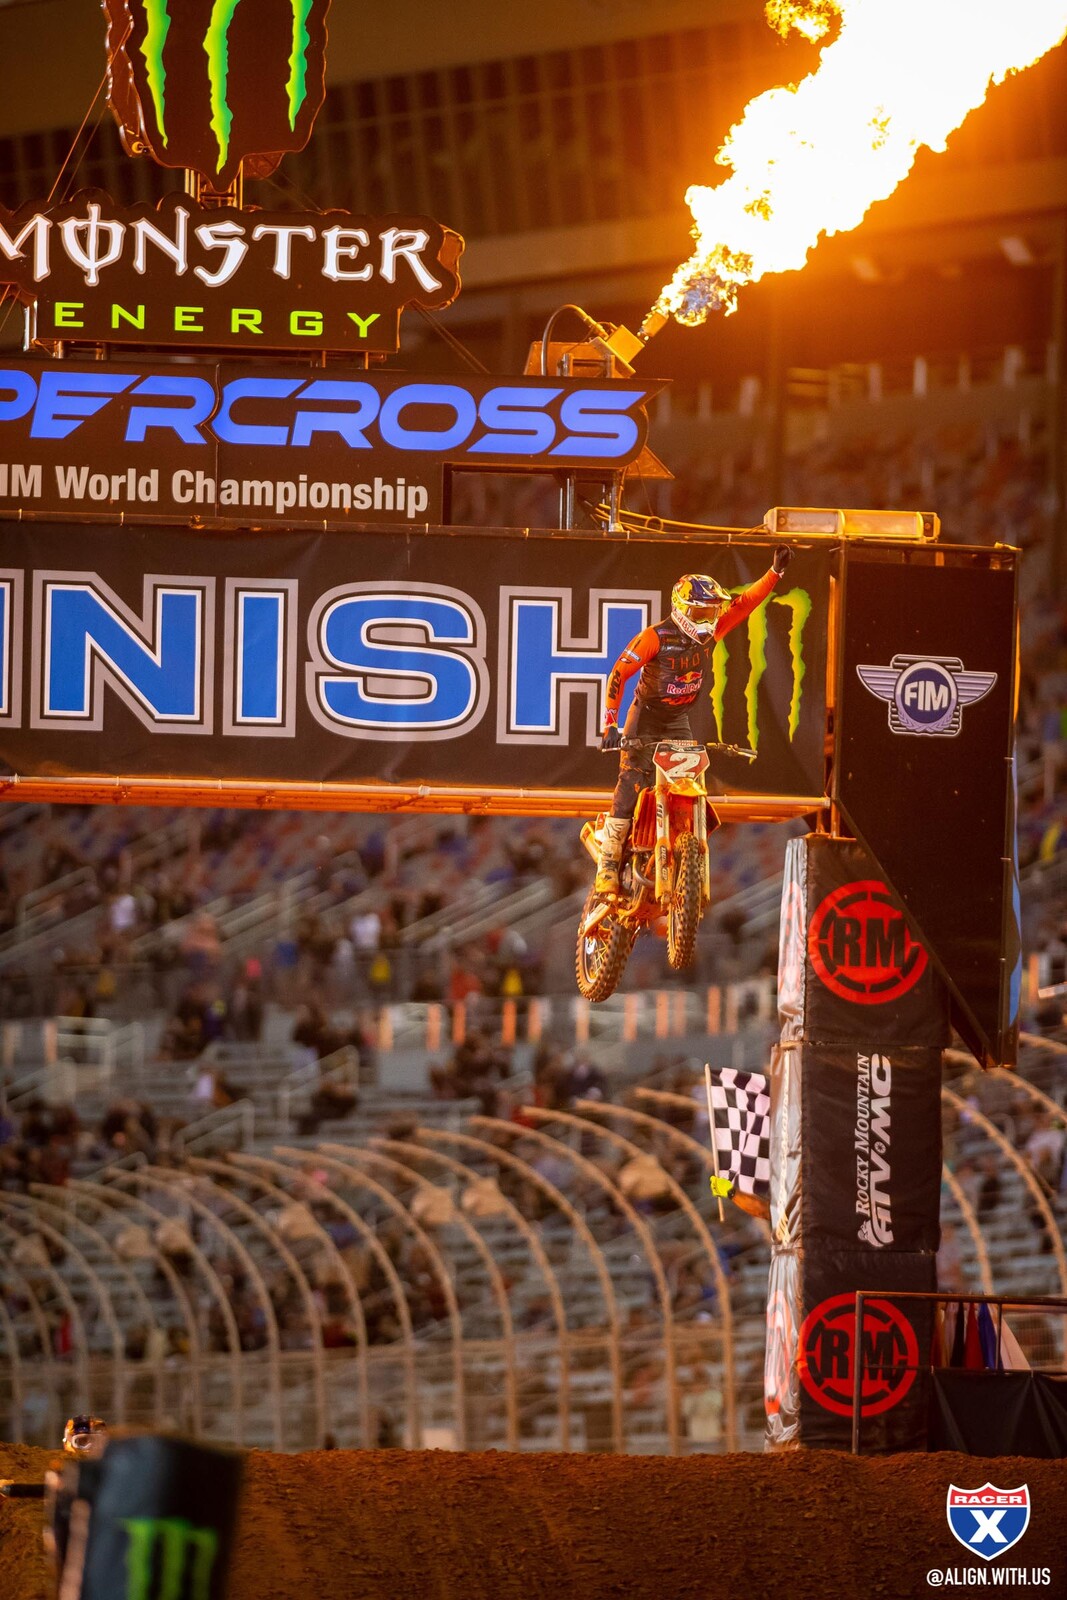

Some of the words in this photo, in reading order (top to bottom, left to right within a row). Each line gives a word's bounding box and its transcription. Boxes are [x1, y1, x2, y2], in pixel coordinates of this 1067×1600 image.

[0, 203, 442, 291] MONSTER
[53, 301, 382, 339] ENERGY
[55, 465, 159, 501] World
[171, 469, 429, 518] Championship
[666, 683, 689, 695] Red
[904, 680, 949, 712] FIM
[665, 752, 701, 778] 2
[832, 917, 906, 967] RM
[855, 1052, 870, 1154] MOUNTAIN
[856, 1165, 870, 1218] ROCKY
[820, 1329, 894, 1381] RM
